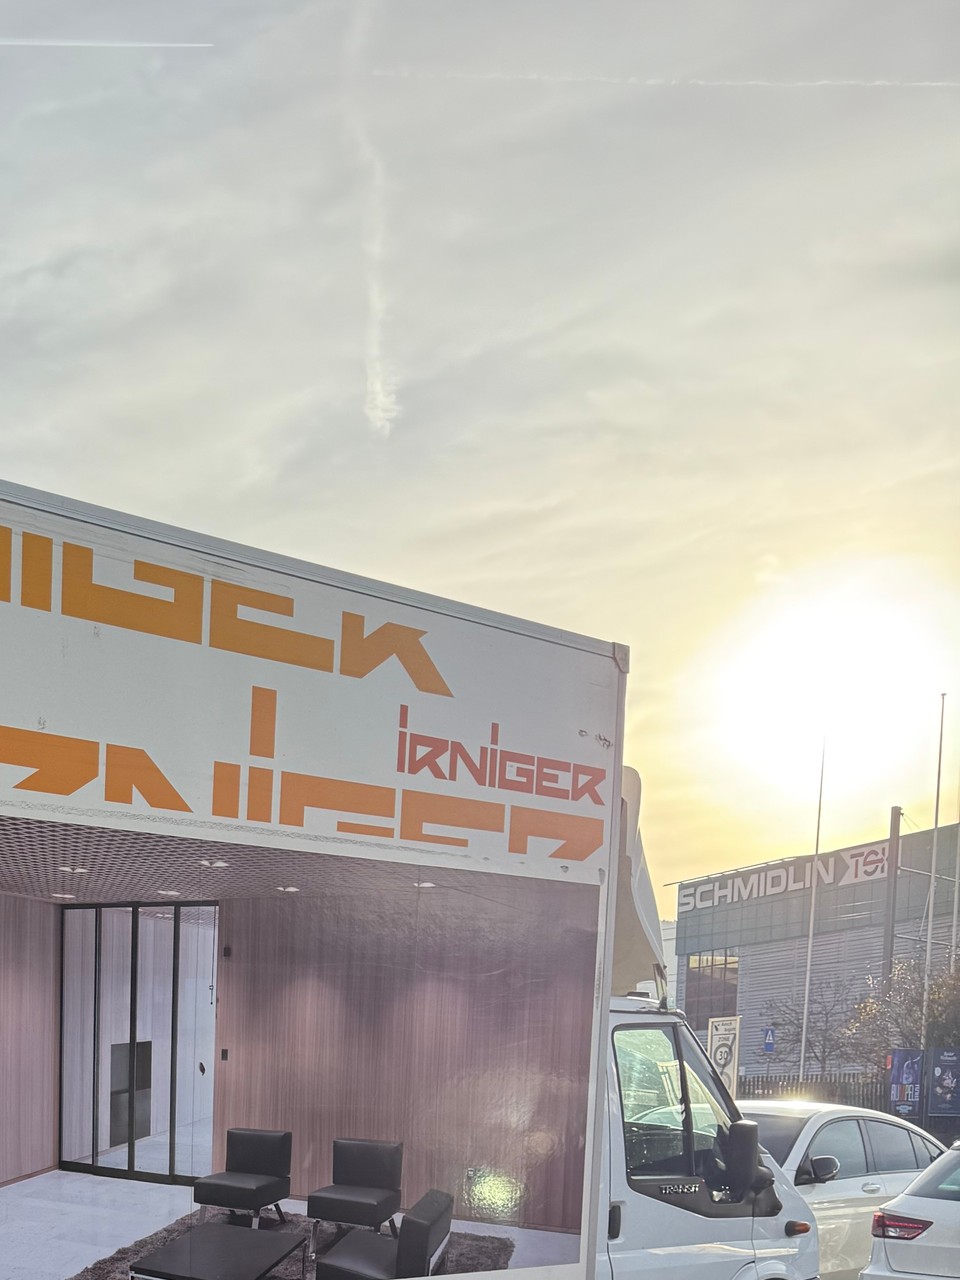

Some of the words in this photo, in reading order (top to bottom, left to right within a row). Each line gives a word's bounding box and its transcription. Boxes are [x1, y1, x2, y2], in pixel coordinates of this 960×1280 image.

[678, 857, 836, 913] SCHMIDLIN
[718, 1050, 729, 1061] 30
[660, 1183, 700, 1195] TRANSIT
